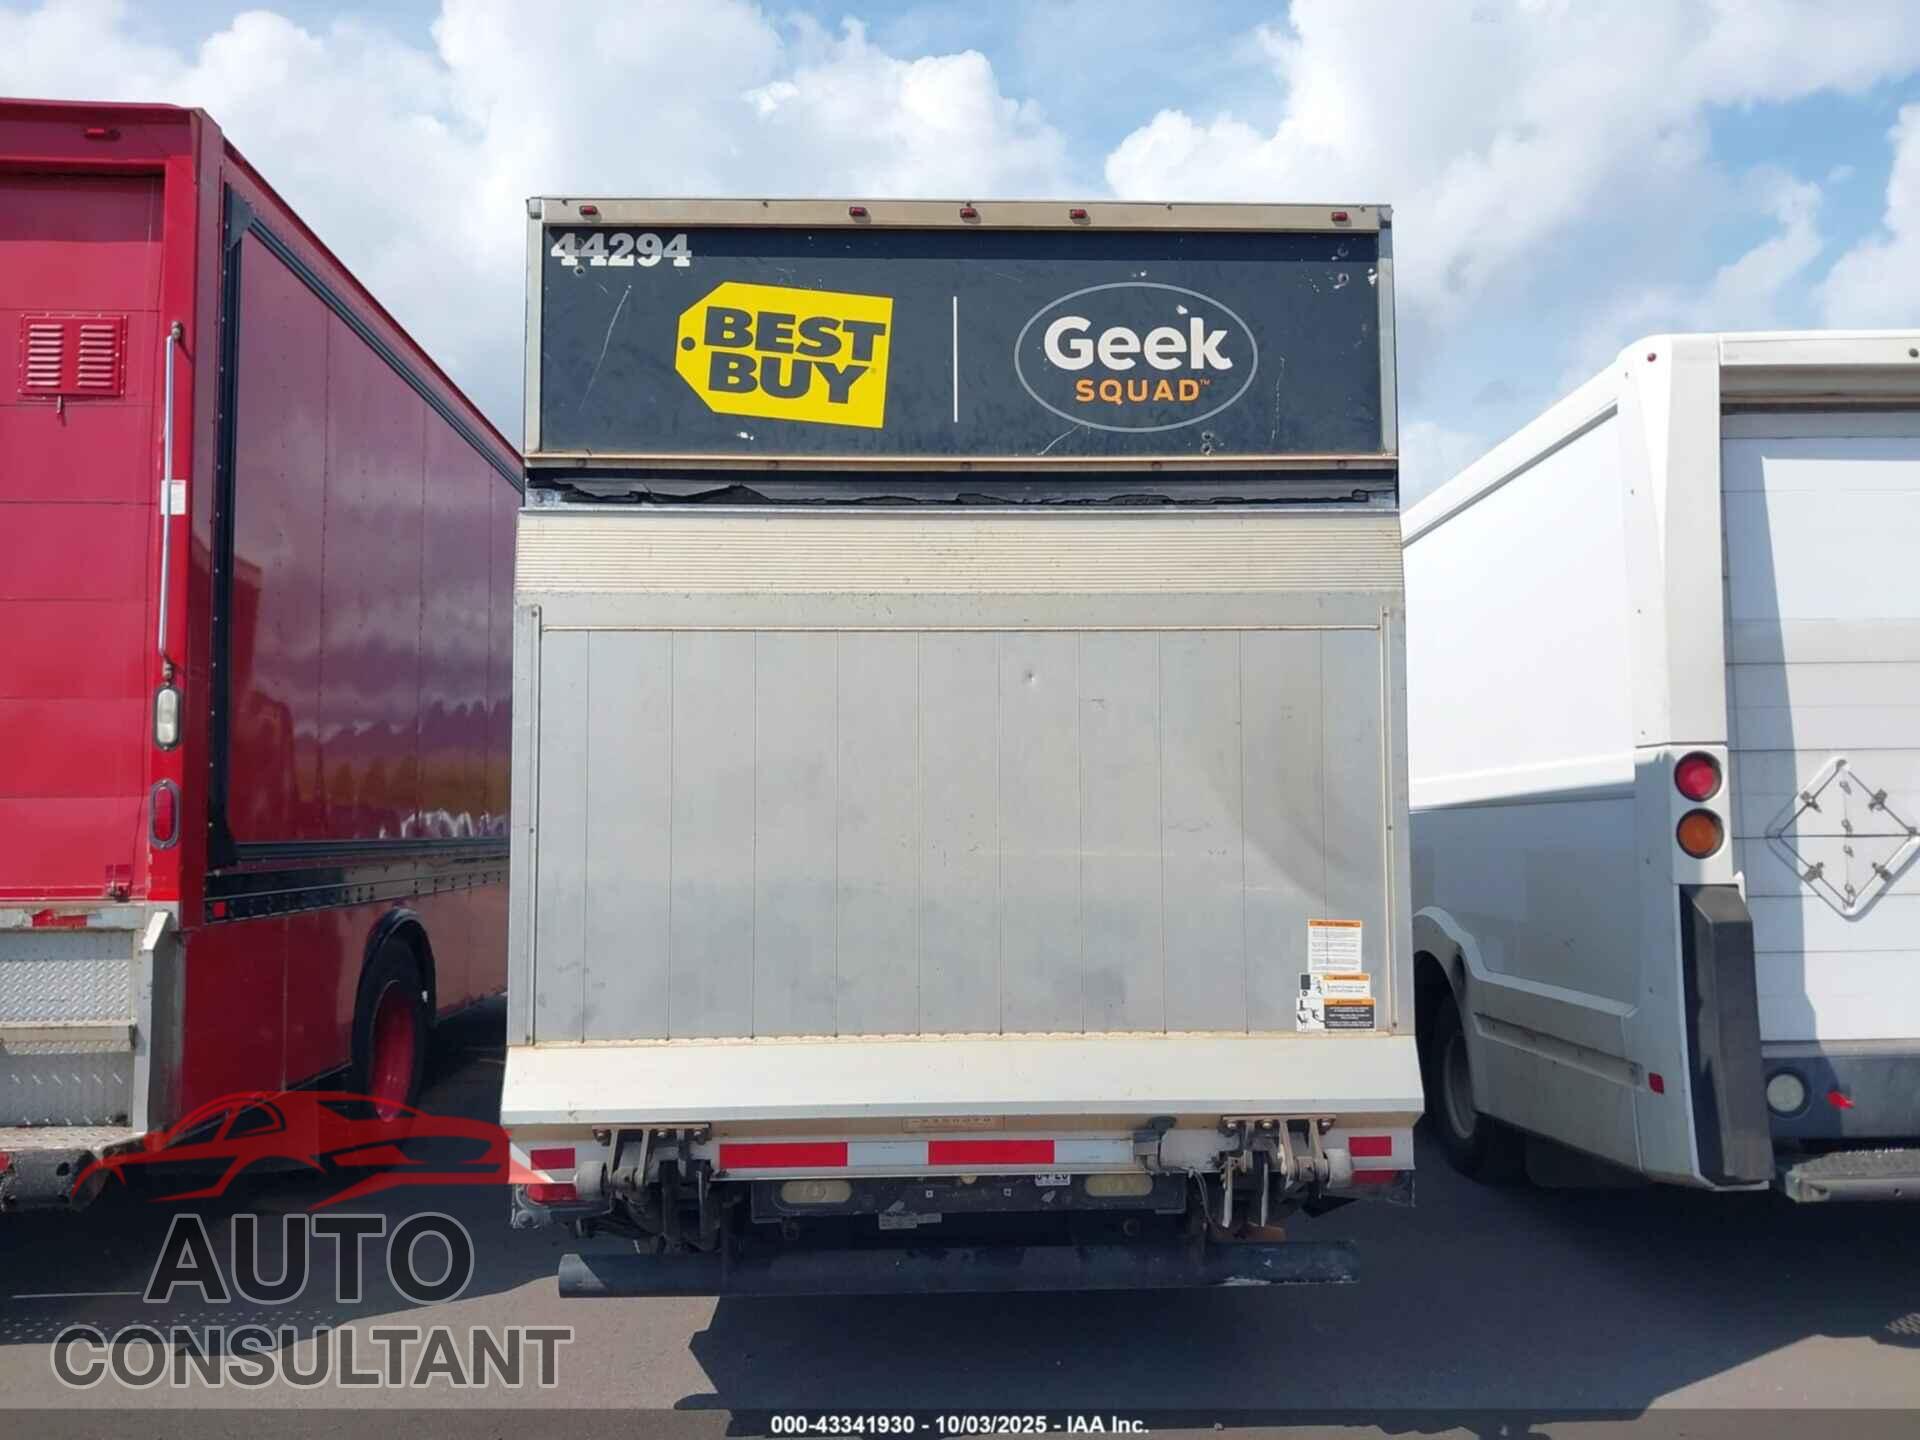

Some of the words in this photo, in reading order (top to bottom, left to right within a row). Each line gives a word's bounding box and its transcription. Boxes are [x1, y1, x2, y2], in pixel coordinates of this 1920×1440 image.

[550, 232, 693, 268] 44294
[703, 305, 887, 362] BEST
[1043, 316, 1234, 371] Geek
[707, 350, 870, 405] BUY
